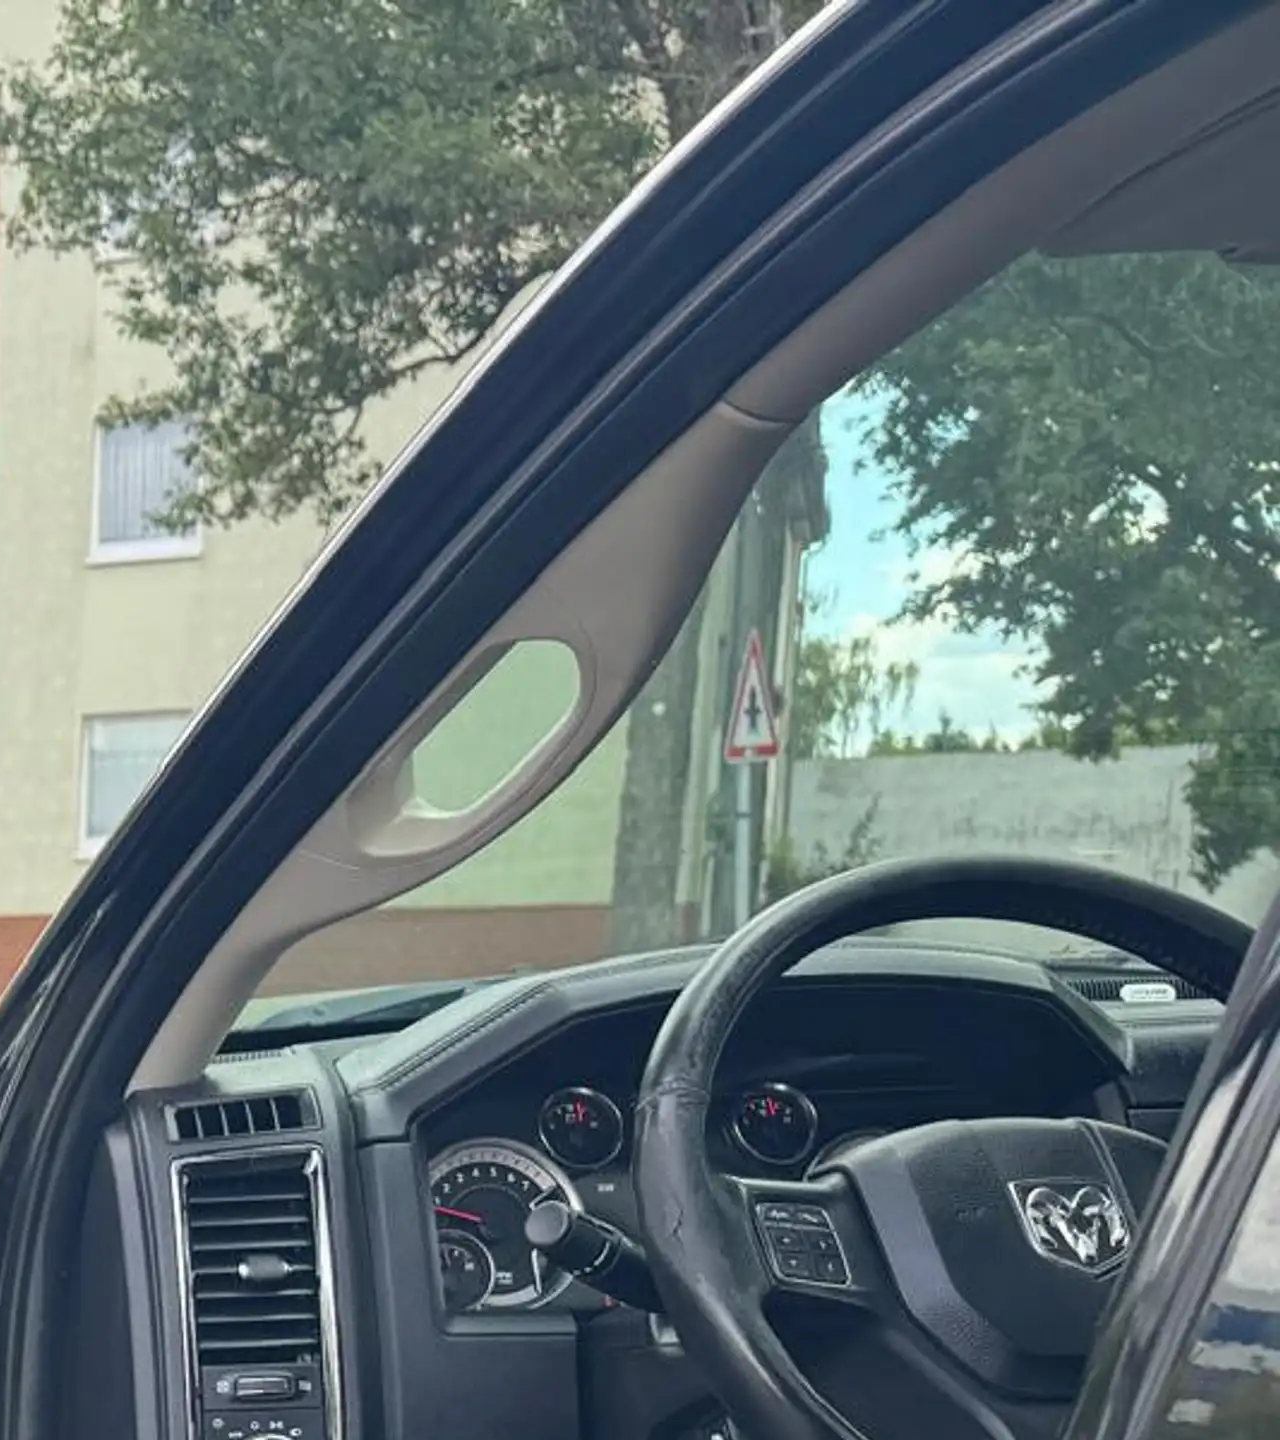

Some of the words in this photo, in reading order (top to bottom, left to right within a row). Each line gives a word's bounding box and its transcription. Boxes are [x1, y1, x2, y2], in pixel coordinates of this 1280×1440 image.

[472, 1167, 480, 1178] 4
[490, 1166, 497, 1177] 5
[521, 1180, 530, 1191] 7
